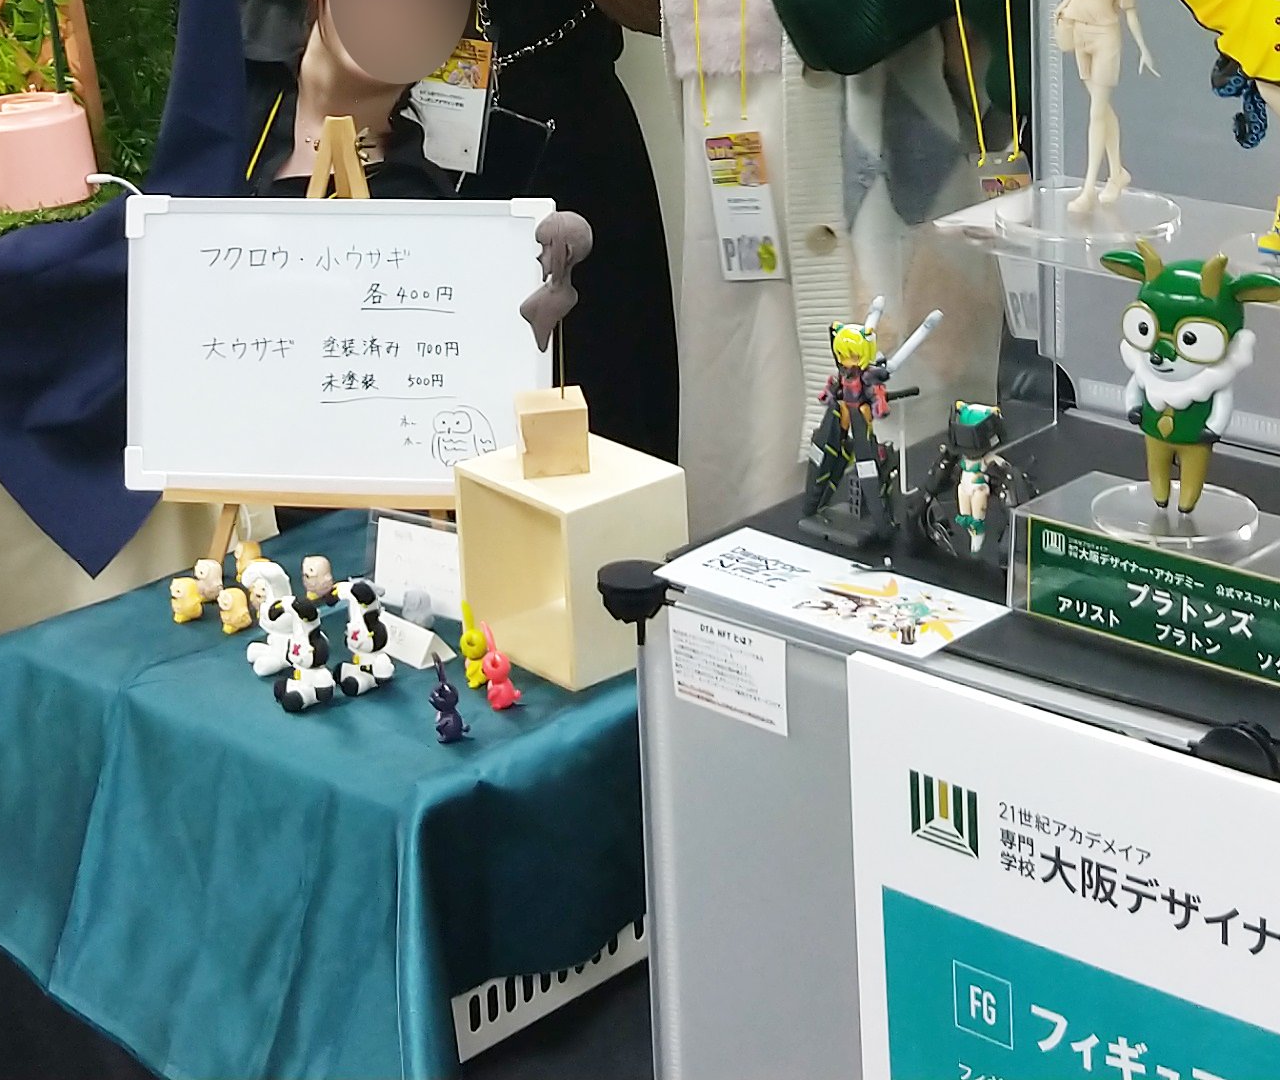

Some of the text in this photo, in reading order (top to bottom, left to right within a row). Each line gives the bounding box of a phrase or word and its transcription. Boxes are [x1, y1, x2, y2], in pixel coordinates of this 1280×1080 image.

[200, 244, 411, 272] フクロウ・小ウサギ
[362, 283, 453, 306] 各 400円
[202, 336, 460, 361] 大ウサギ 塗装済み 700円
[321, 372, 444, 392] 未塗装 500円
[1078, 546, 1205, 591] 大阪デザイナー・アカデミー
[1057, 595, 1121, 628] アリスト
[1126, 581, 1256, 640] プラトンズ
[1155, 622, 1221, 655] プラトン
[998, 801, 1152, 865] 21世紀アカデメイア
[999, 827, 1034, 858] 専門
[1000, 850, 1036, 881] 学校
[969, 984, 997, 1026] FG
